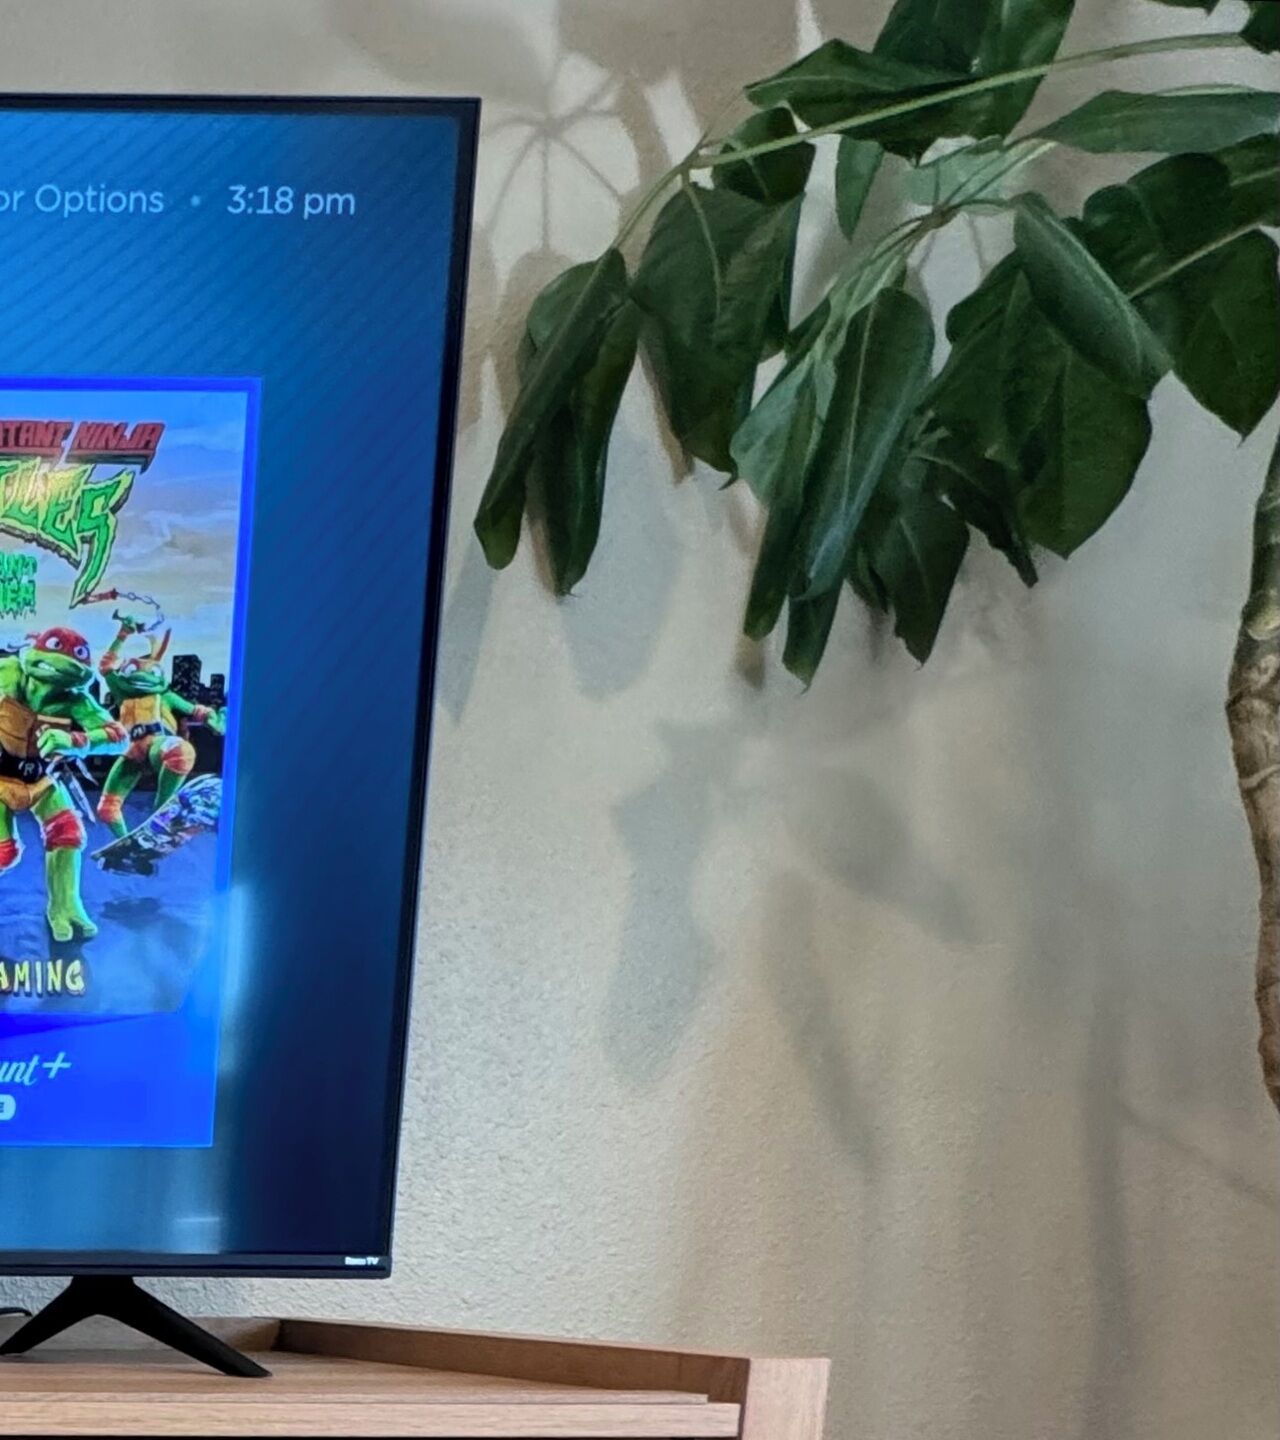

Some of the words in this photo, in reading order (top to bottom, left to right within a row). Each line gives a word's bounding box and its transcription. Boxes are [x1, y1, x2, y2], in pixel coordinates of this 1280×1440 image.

[35, 184, 164, 217] Options
[227, 184, 294, 215] 3:18
[303, 191, 356, 219] pm
[66, 421, 165, 468] NINJA
